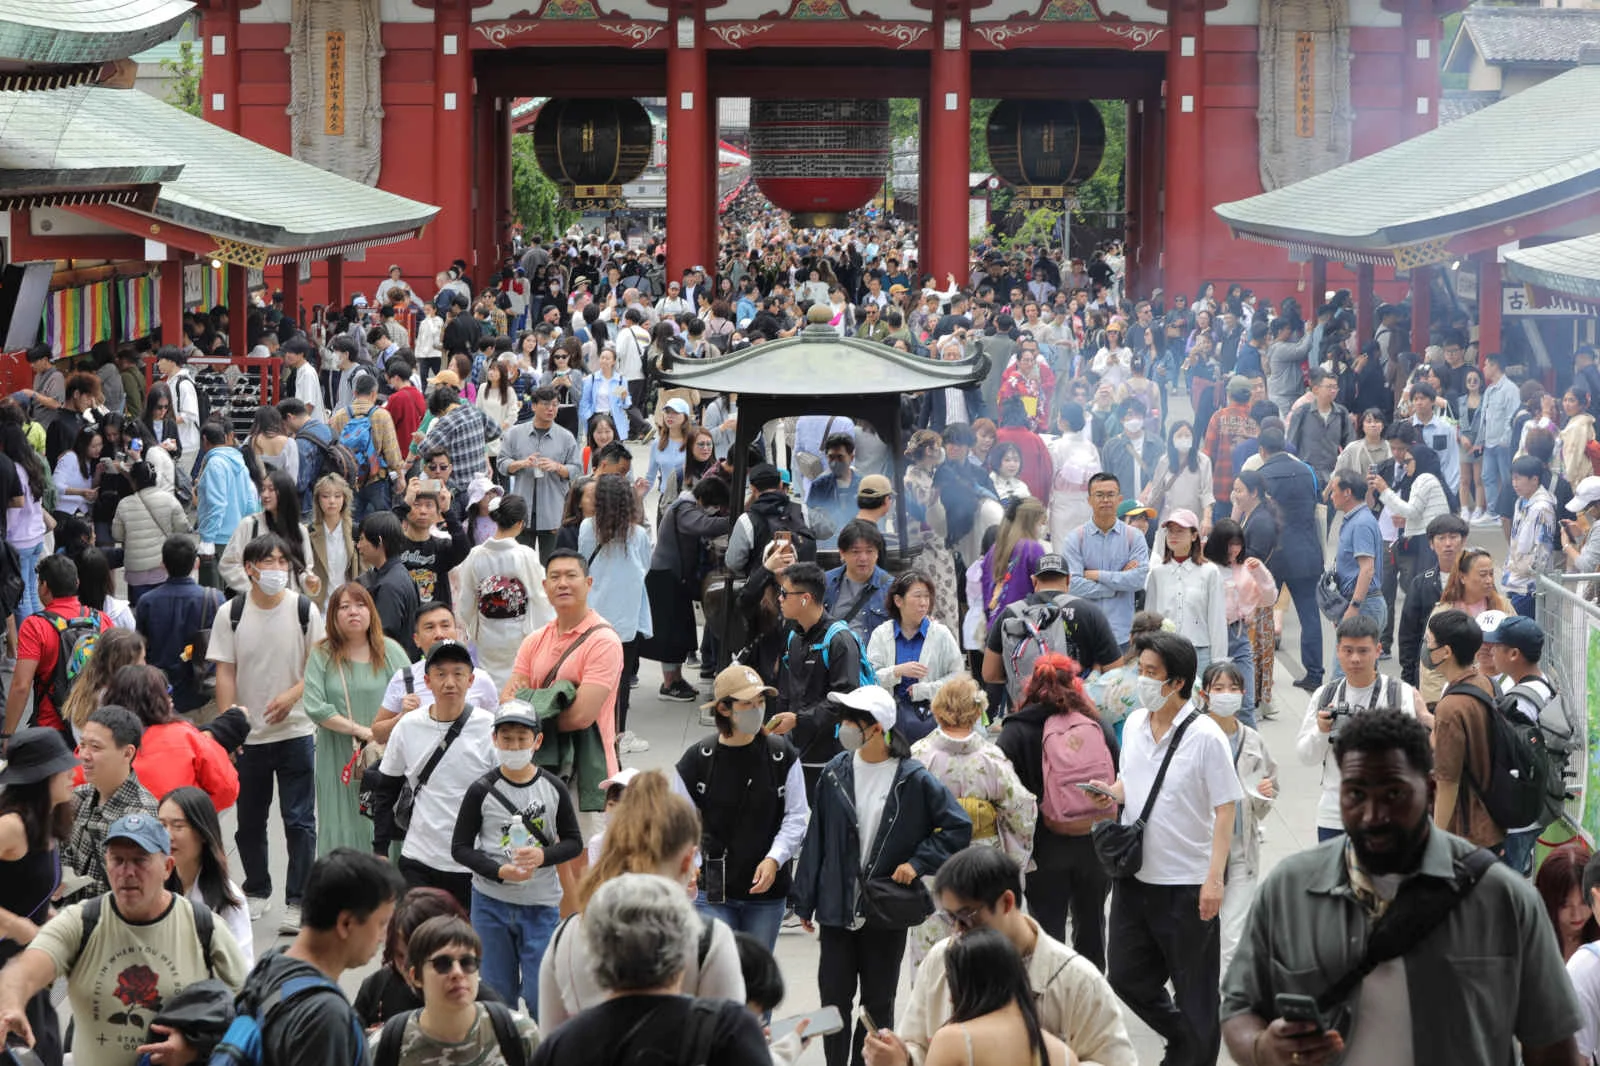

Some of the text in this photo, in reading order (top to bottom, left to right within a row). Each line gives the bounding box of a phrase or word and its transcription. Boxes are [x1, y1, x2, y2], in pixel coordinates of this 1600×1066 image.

[94, 981, 102, 996] FIT
[109, 947, 135, 963] WHEN
[138, 946, 158, 956] YOU
[160, 954, 179, 976] WERE
[117, 1035, 145, 1043] STAN
